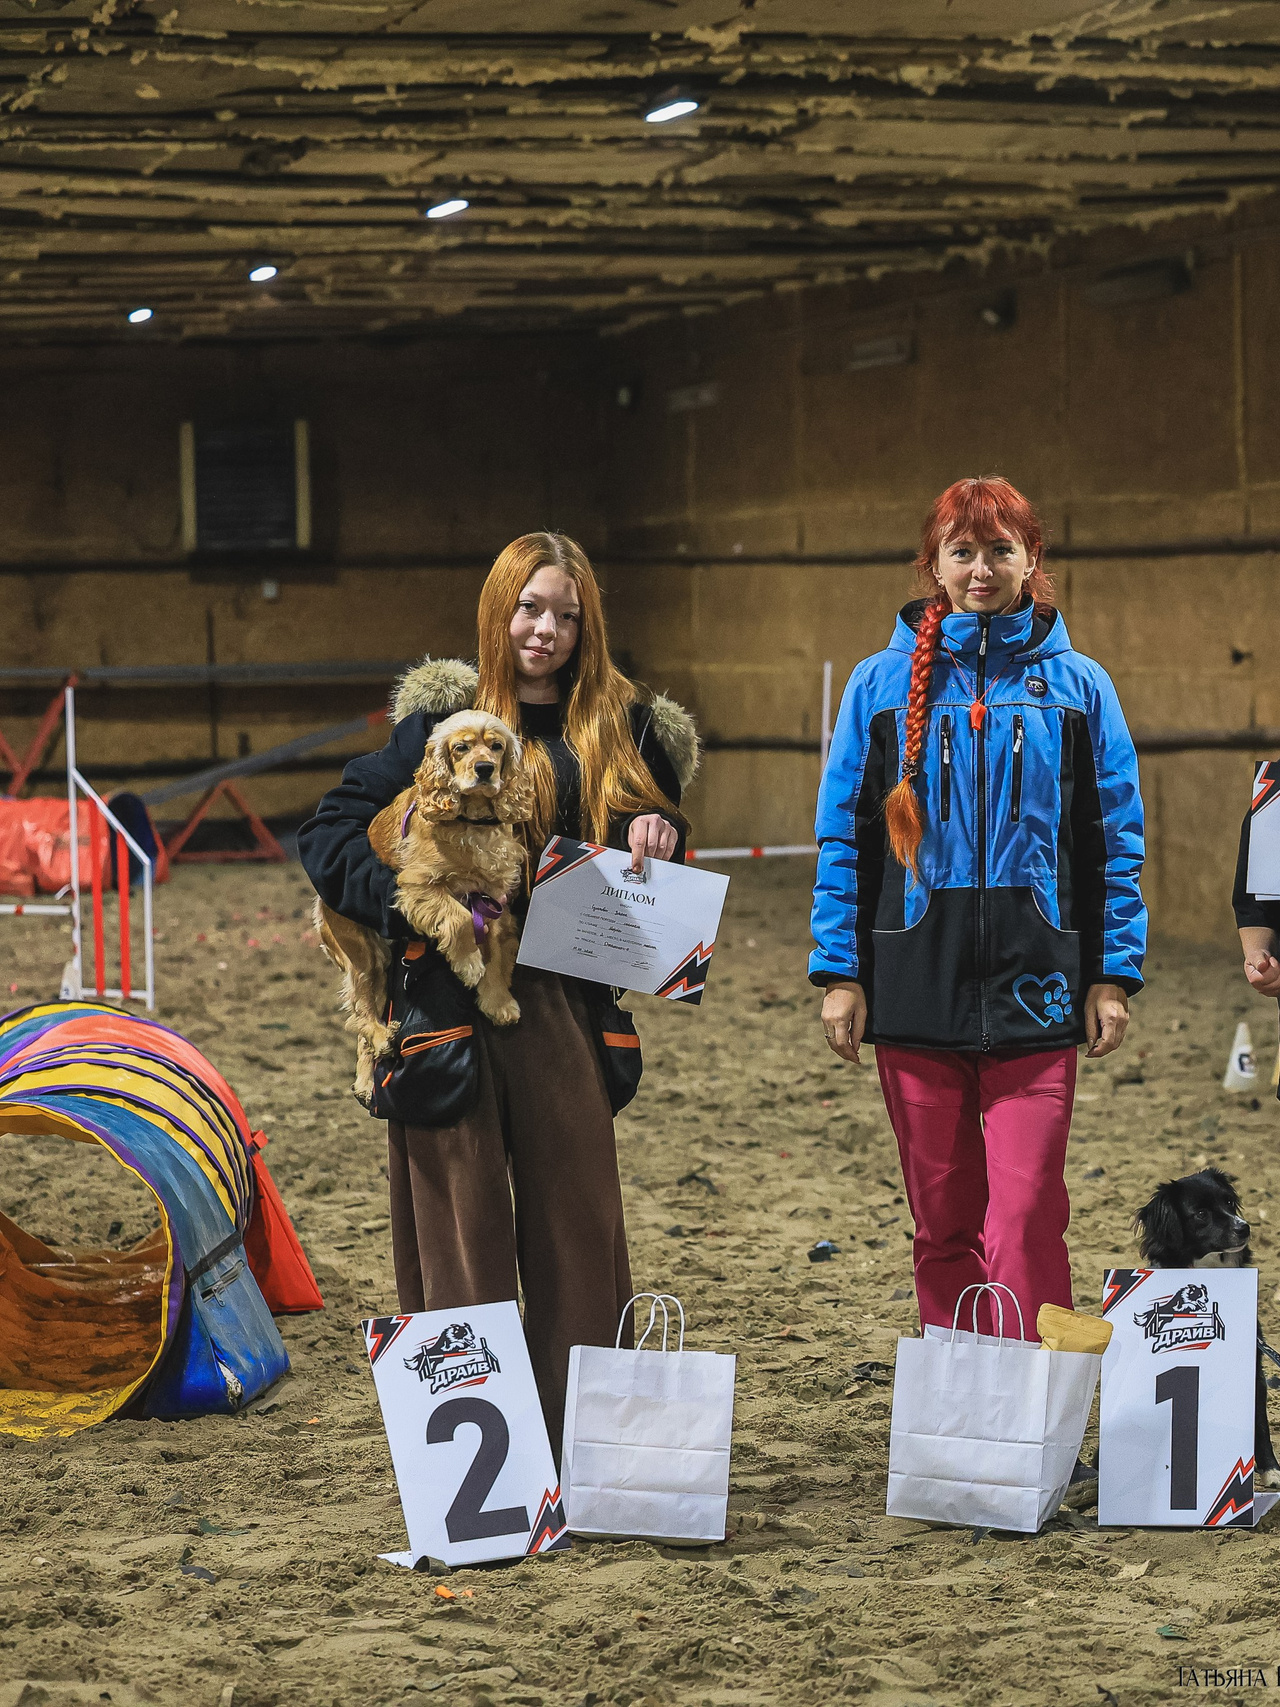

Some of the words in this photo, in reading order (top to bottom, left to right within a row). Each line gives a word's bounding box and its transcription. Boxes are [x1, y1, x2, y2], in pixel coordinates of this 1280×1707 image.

[601, 886, 656, 906] ДИПЛОМ
[426, 1397, 531, 1543] 2
[1155, 1366, 1200, 1510] 1
